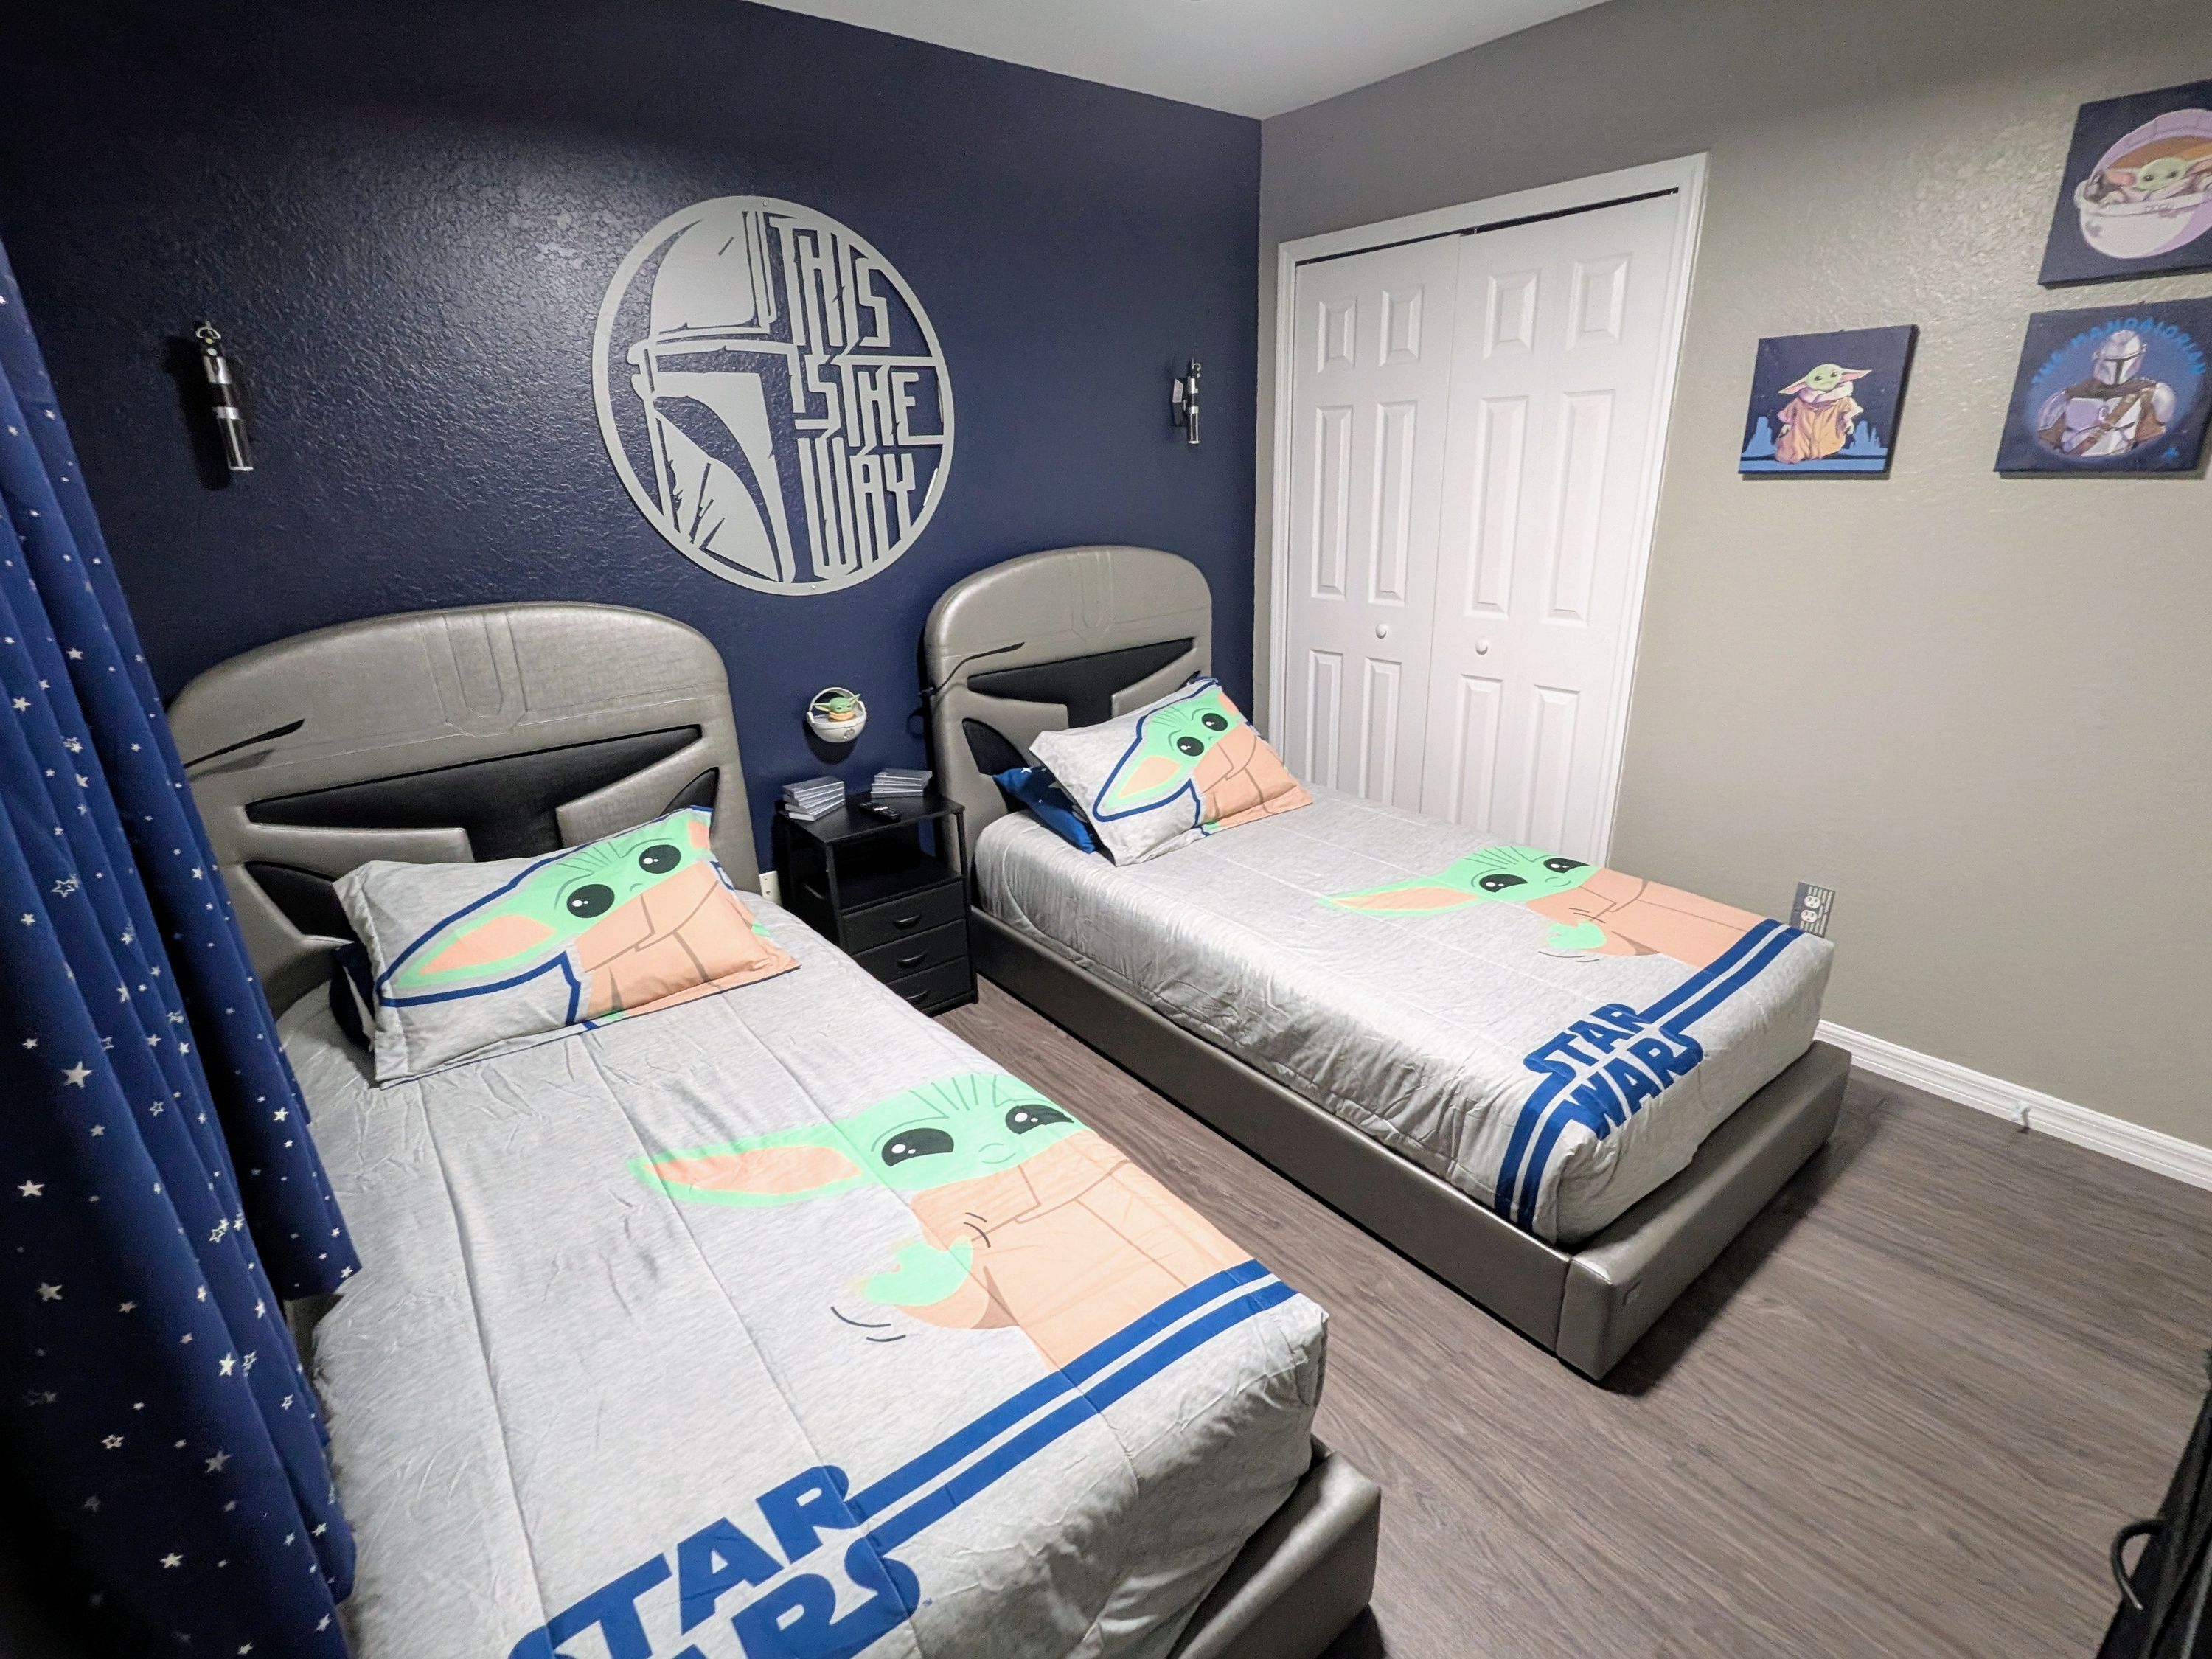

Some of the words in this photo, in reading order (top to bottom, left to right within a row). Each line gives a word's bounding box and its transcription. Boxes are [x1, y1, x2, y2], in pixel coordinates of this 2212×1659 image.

[769, 215, 891, 355] THIS
[789, 345, 842, 429] IS
[831, 351, 945, 446] THE
[797, 431, 916, 578] WAY
[1523, 1004, 1647, 1082] STAR
[1557, 1026, 1704, 1141] WARS
[668, 1535, 920, 1659] RS
